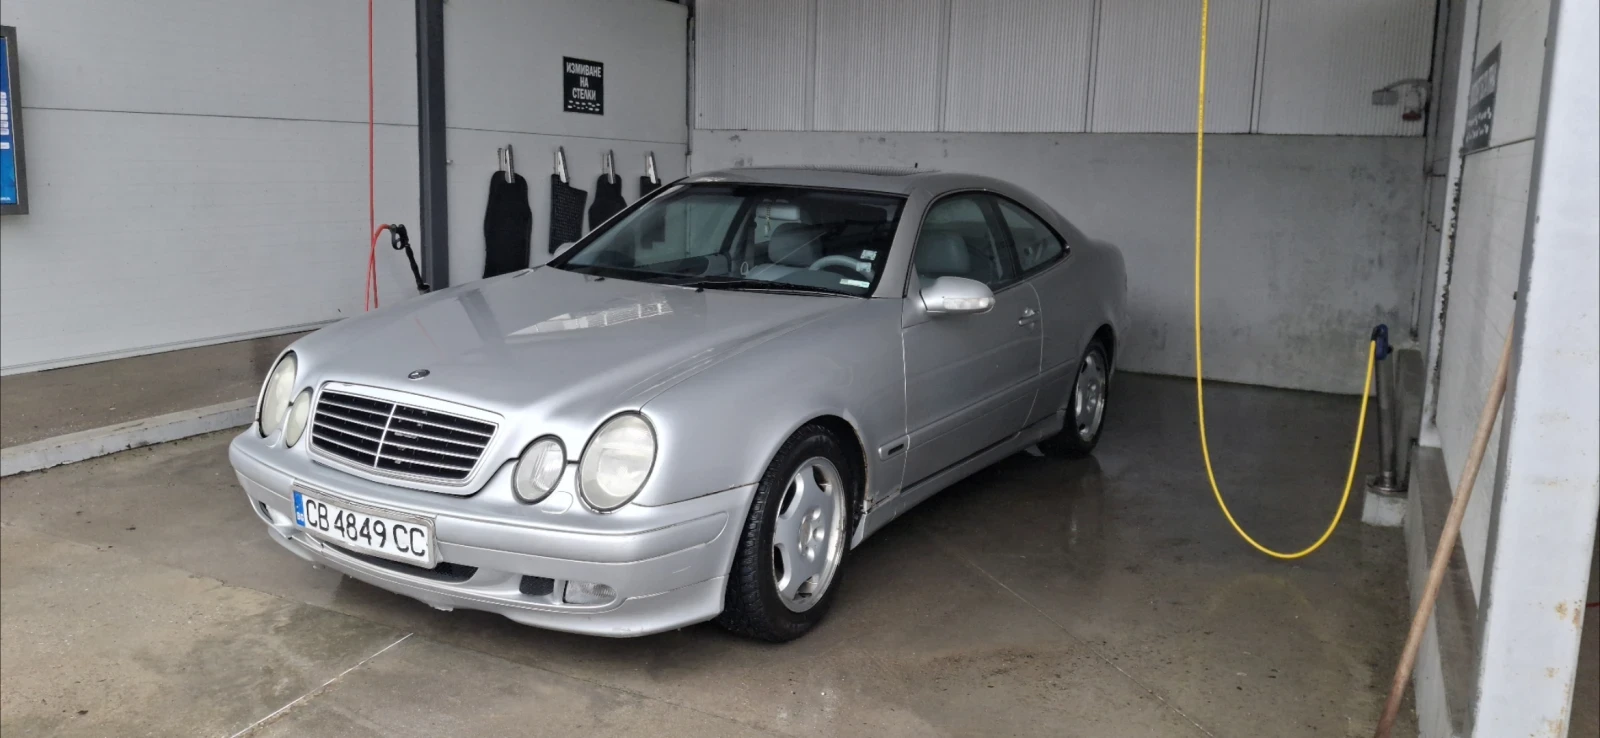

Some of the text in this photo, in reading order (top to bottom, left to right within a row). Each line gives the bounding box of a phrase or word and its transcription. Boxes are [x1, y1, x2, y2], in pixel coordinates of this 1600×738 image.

[566, 61, 602, 78] ИЗМИВАНЕ
[579, 76, 589, 88] НА
[572, 87, 597, 101] СТЕЛКИ
[305, 499, 426, 557] CB 4849 CC
